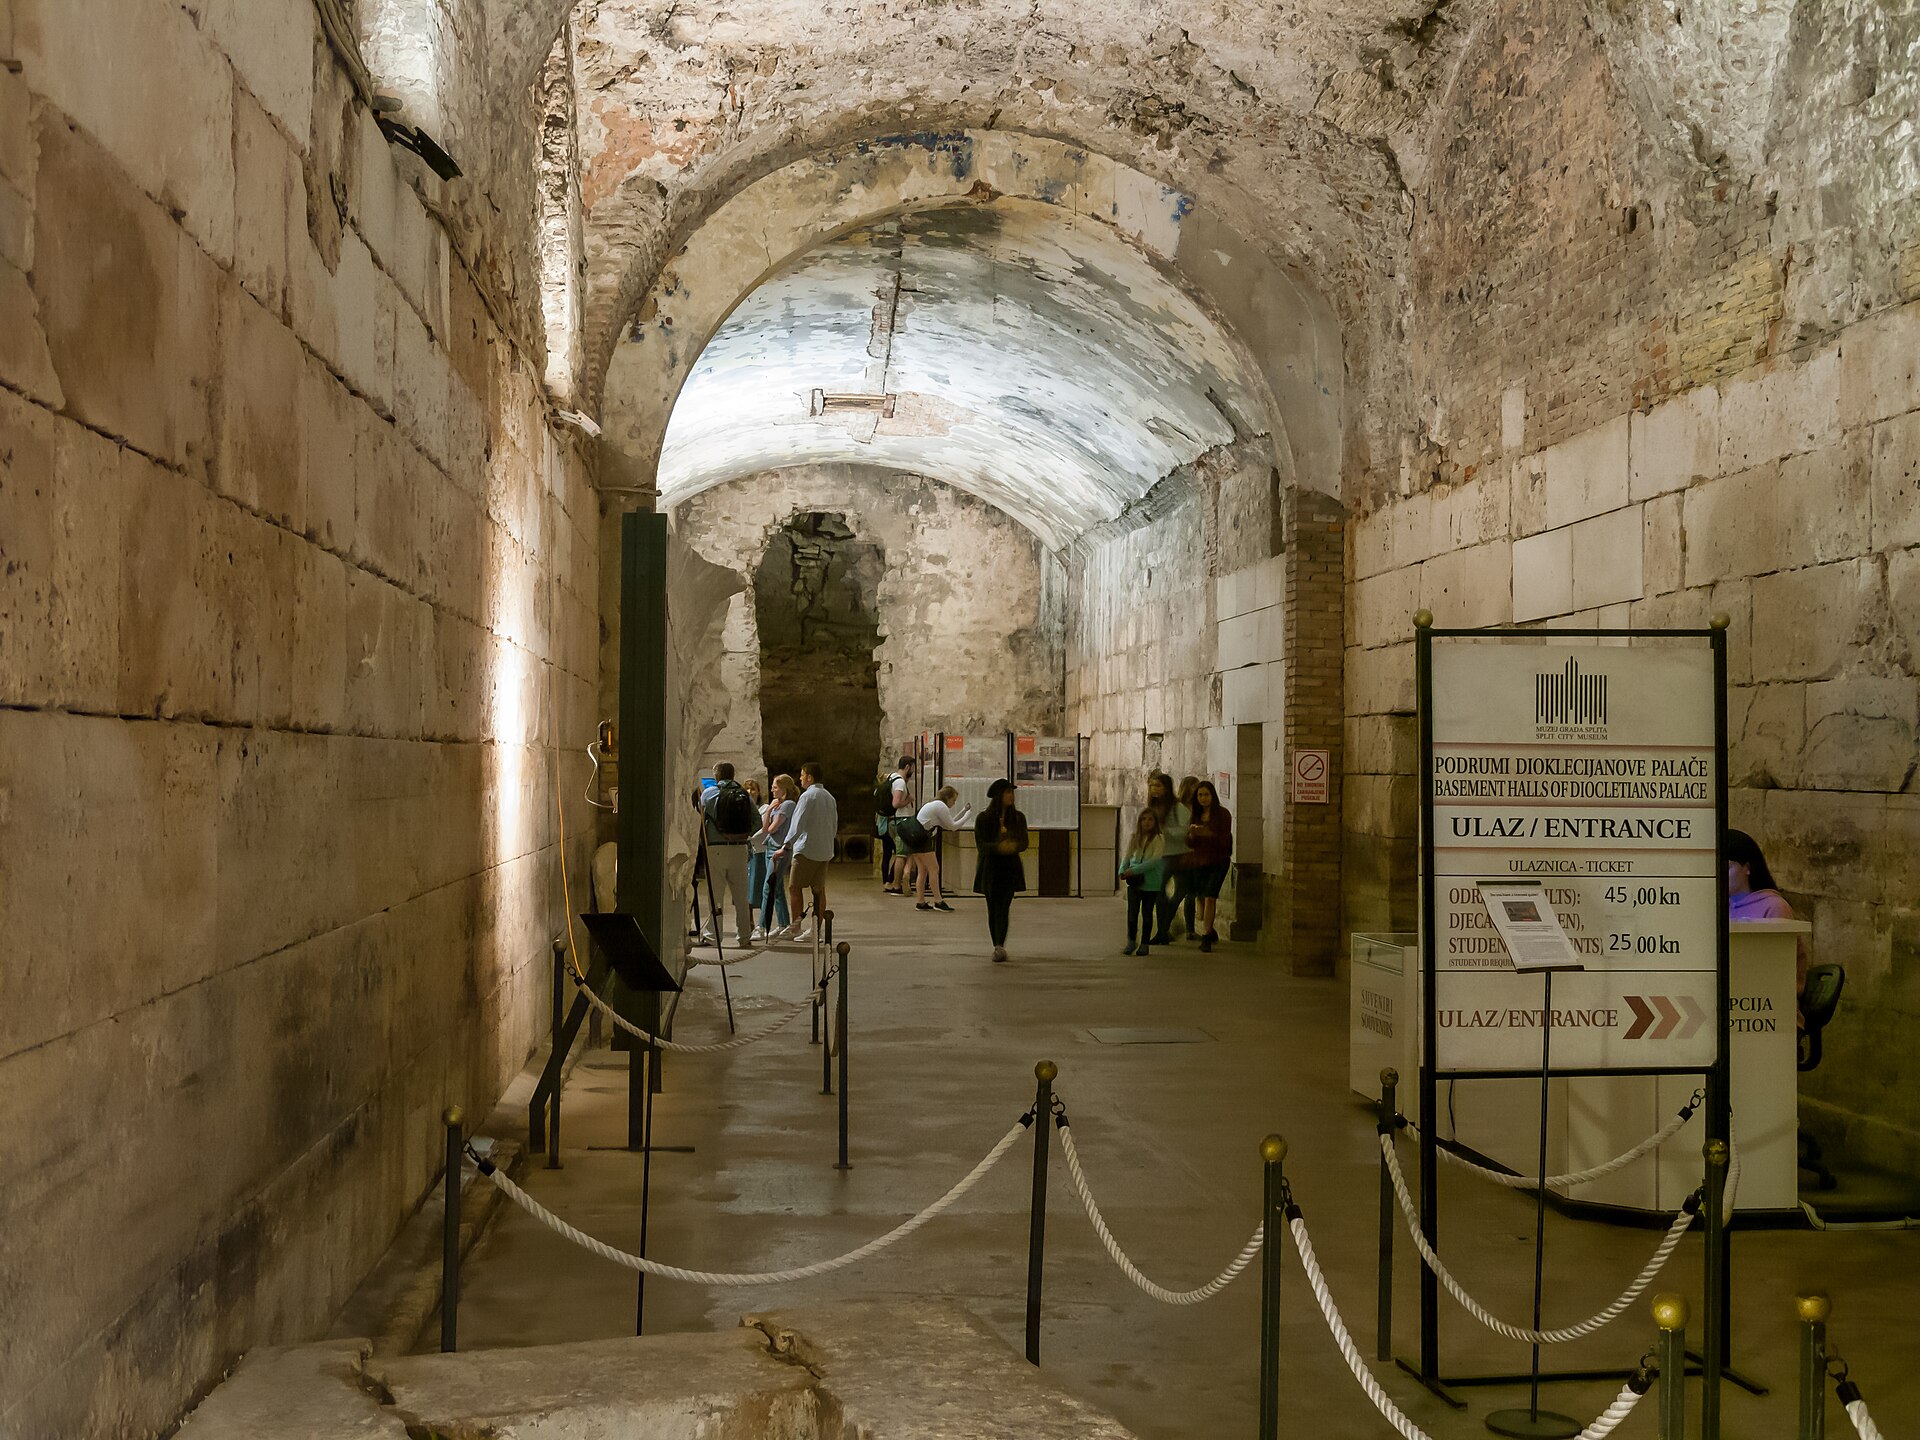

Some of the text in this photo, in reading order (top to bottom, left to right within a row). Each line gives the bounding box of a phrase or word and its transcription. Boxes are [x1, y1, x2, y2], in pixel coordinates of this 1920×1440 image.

[1577, 733, 1608, 741] MUSEUM
[1434, 755, 1708, 778] PODRUMI DIOKLECIJANOVE PALAČE
[1434, 779, 1708, 799] BASEMENT HALLS OF DIOCLETIANS PALACE
[1451, 817, 1692, 839] ULAZ / ENTRANCE
[1508, 860, 1578, 872] ULAZNICA
[1585, 861, 1634, 872] TICKET
[1659, 886, 1681, 905] kn
[1449, 937, 1507, 953] STUDEN
[1659, 935, 1681, 953] kn
[1481, 958, 1489, 967] ID
[1361, 989, 1393, 1015] SUVENIRI
[1729, 997, 1774, 1012] PCIJA
[1361, 1012, 1393, 1039] SOUVENIRS
